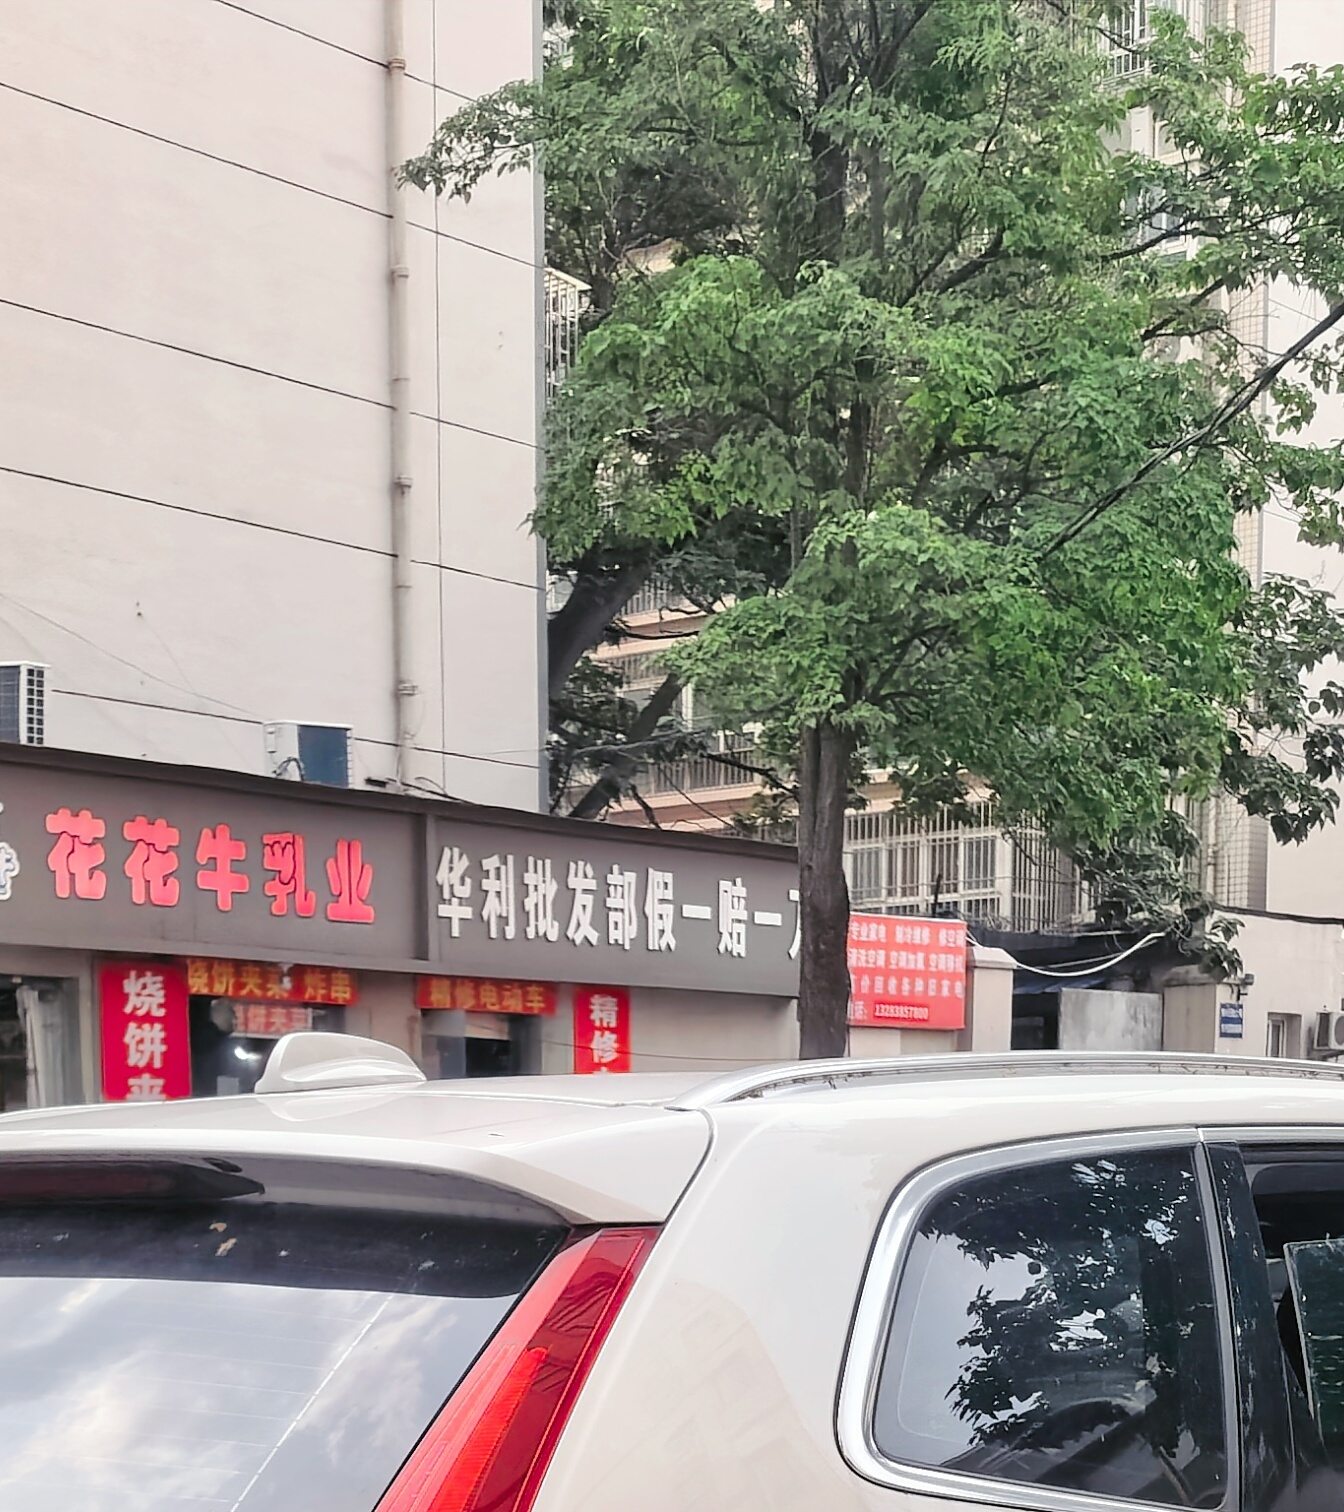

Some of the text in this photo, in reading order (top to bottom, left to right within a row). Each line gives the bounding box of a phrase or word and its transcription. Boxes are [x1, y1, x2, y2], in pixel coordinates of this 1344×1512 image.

[45, 807, 374, 924] 花花牛乳业
[436, 846, 801, 959] 华利批发部假一赔一
[304, 965, 352, 1001] 炸串
[589, 993, 619, 1073] 精修
